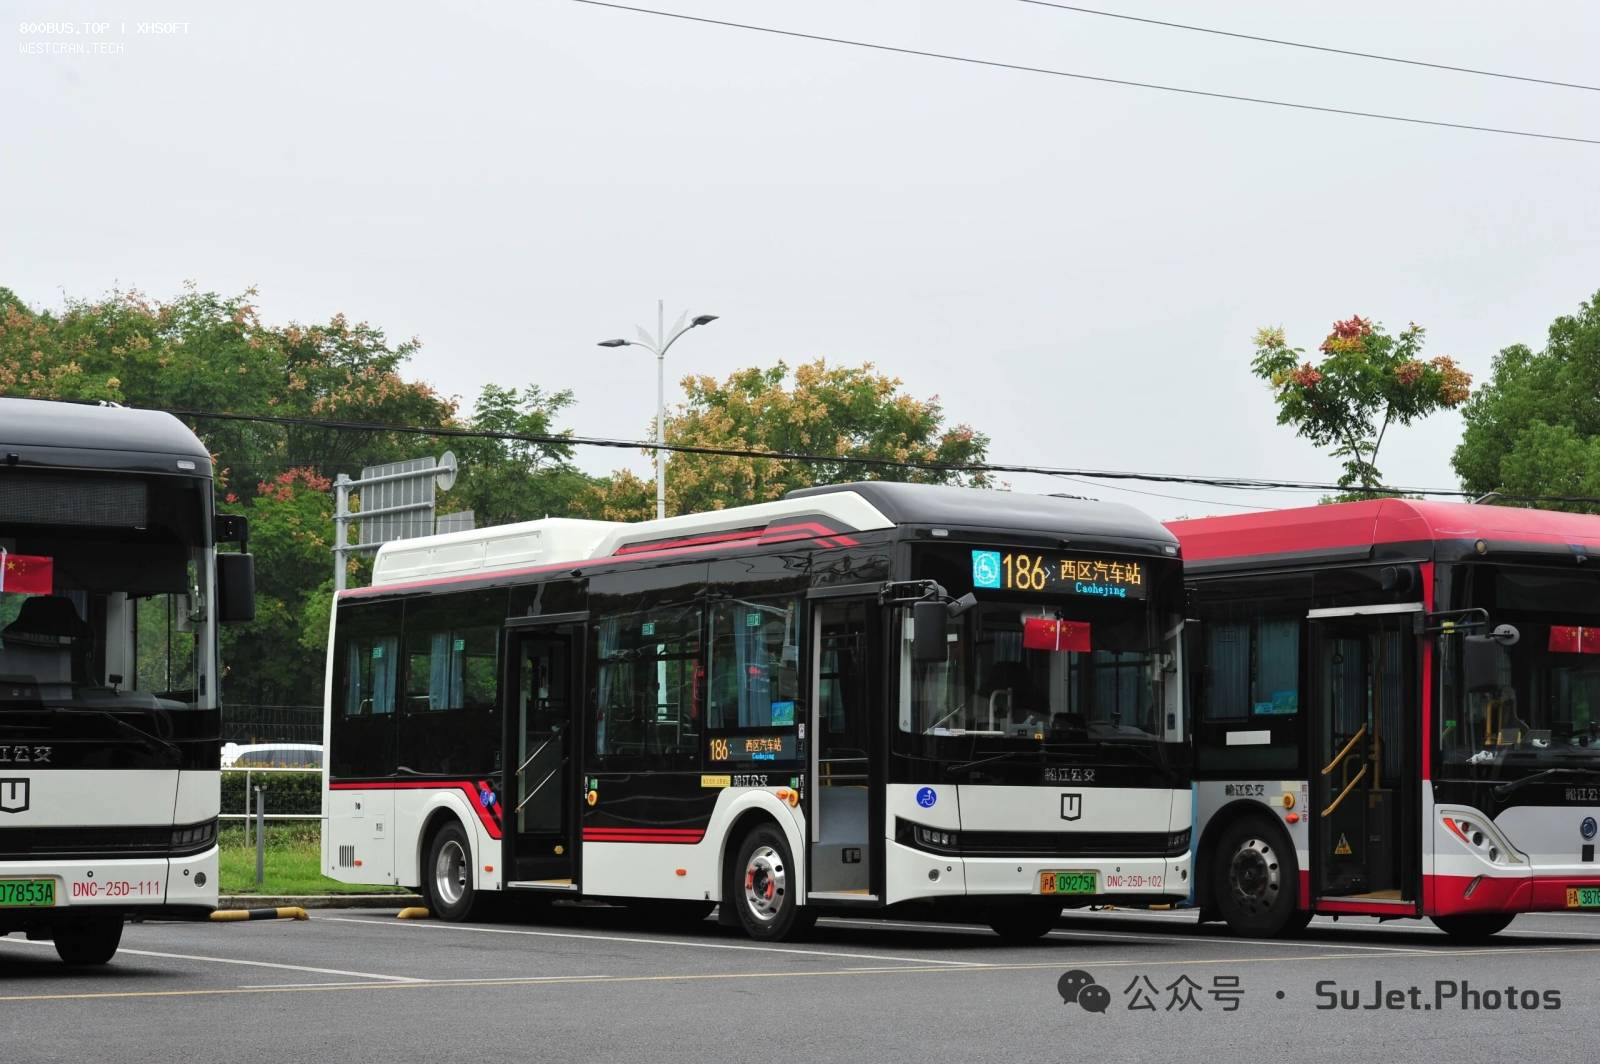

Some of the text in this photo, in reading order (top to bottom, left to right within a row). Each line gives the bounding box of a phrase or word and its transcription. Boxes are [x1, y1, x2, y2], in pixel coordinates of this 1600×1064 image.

[1002, 553, 1046, 590] 186
[1060, 559, 1141, 585] 西区汽车站
[1075, 582, 1126, 597] Caohejing
[709, 738, 728, 760] 186
[73, 880, 160, 897] DNC-25D-111
[1059, 875, 1096, 891] 09275A
[1107, 875, 1162, 888] DNC-25D-102
